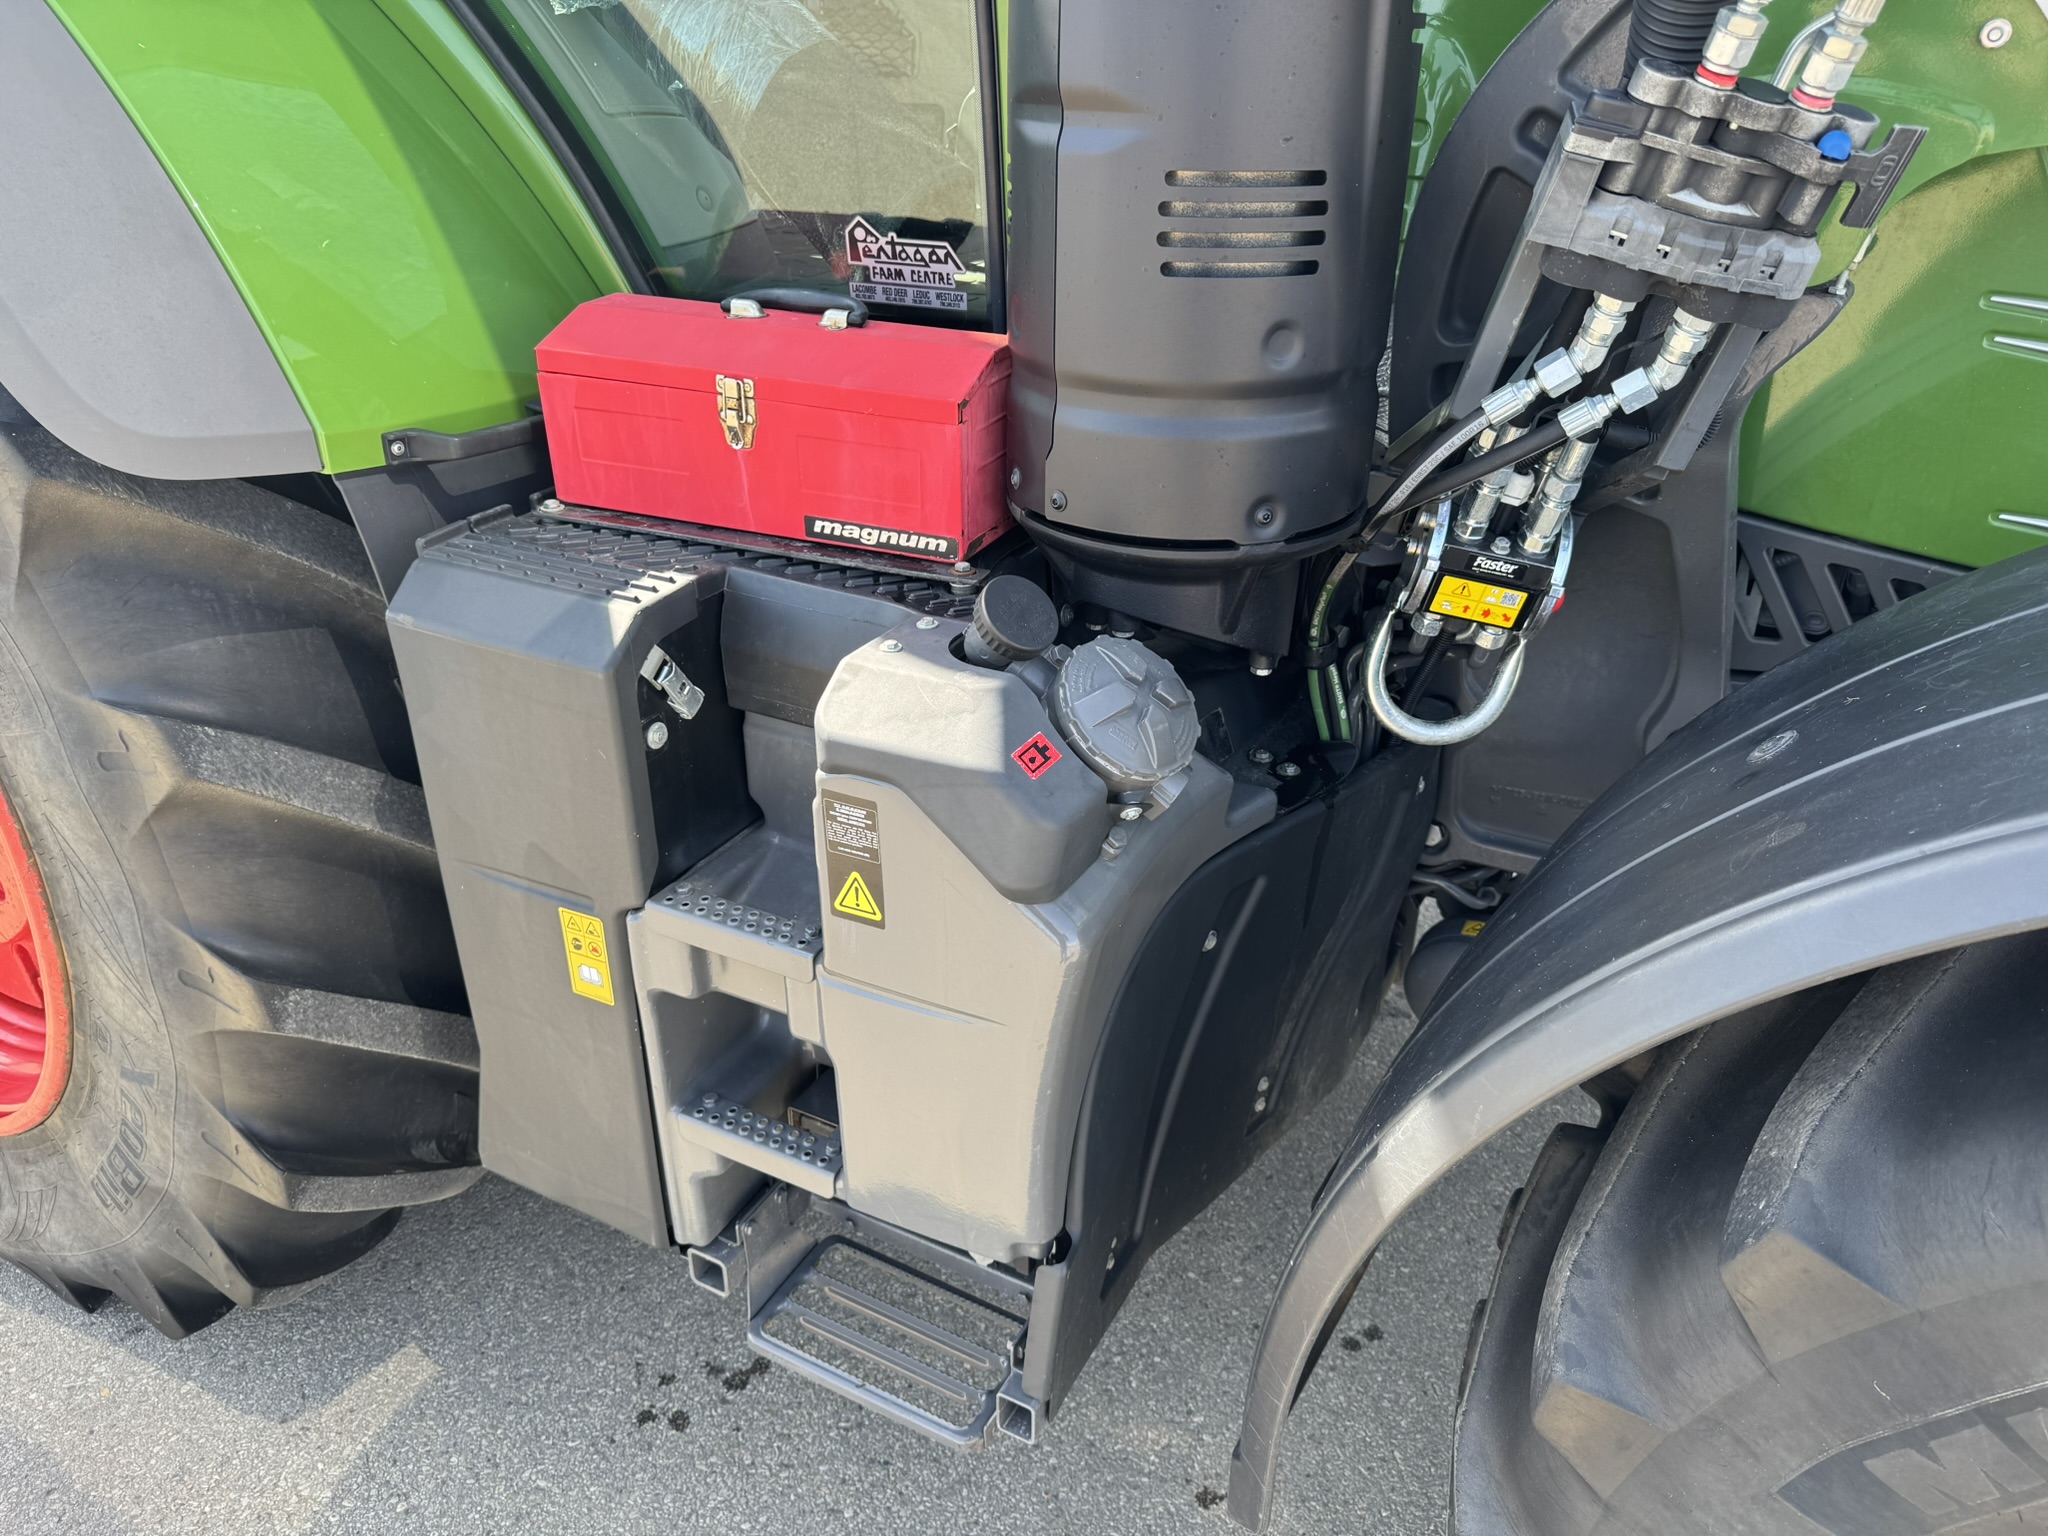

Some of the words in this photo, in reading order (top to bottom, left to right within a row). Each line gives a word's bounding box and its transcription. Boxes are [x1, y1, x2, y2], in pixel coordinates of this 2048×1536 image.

[872, 266, 907, 282] FARM
[910, 269, 953, 287] CENTRE
[852, 284, 877, 295] LACOMBE
[881, 286, 893, 296] RED
[893, 288, 908, 298] DEER
[912, 289, 931, 300] LEDUC
[935, 291, 965, 303] WESTLOCK
[813, 519, 948, 553] magnum
[1473, 556, 1519, 574] Faster
